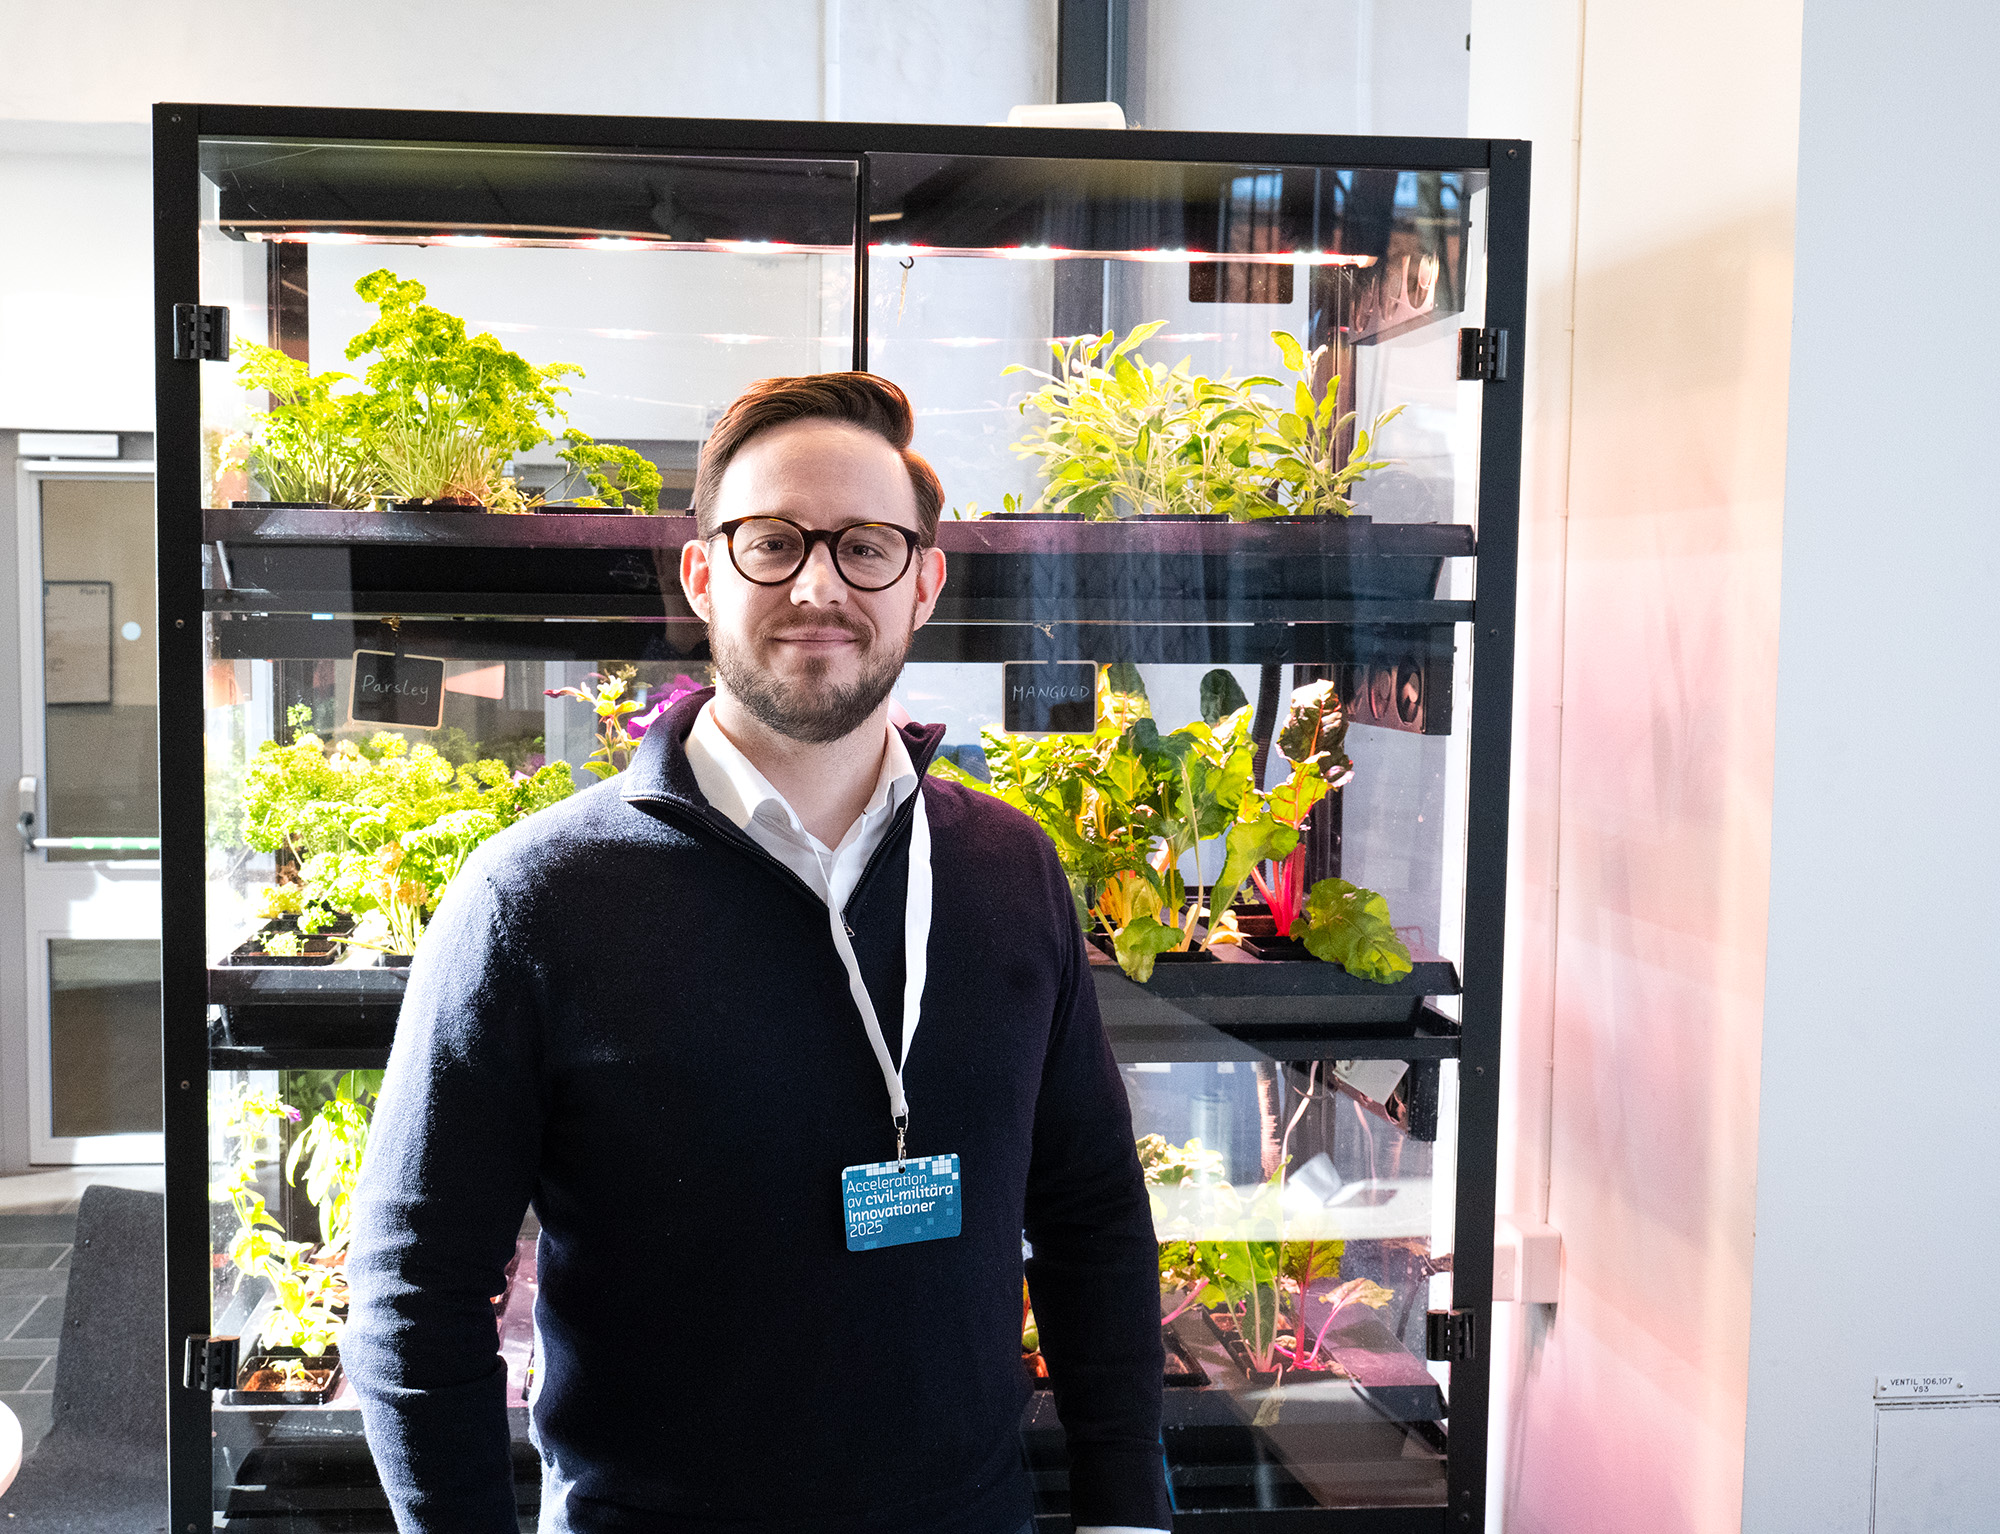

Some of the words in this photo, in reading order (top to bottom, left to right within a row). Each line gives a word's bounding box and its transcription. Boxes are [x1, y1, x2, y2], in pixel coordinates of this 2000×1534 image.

[362, 674, 429, 705] Parsley
[1012, 685, 1090, 701] MANGOLD
[846, 1173, 927, 1194] Acceleration
[847, 1197, 863, 1208] av
[865, 1184, 954, 1205] civil-militära
[848, 1201, 936, 1223] Innovationer
[849, 1220, 883, 1238] 2025
[1890, 1378, 1919, 1386] VENTIL
